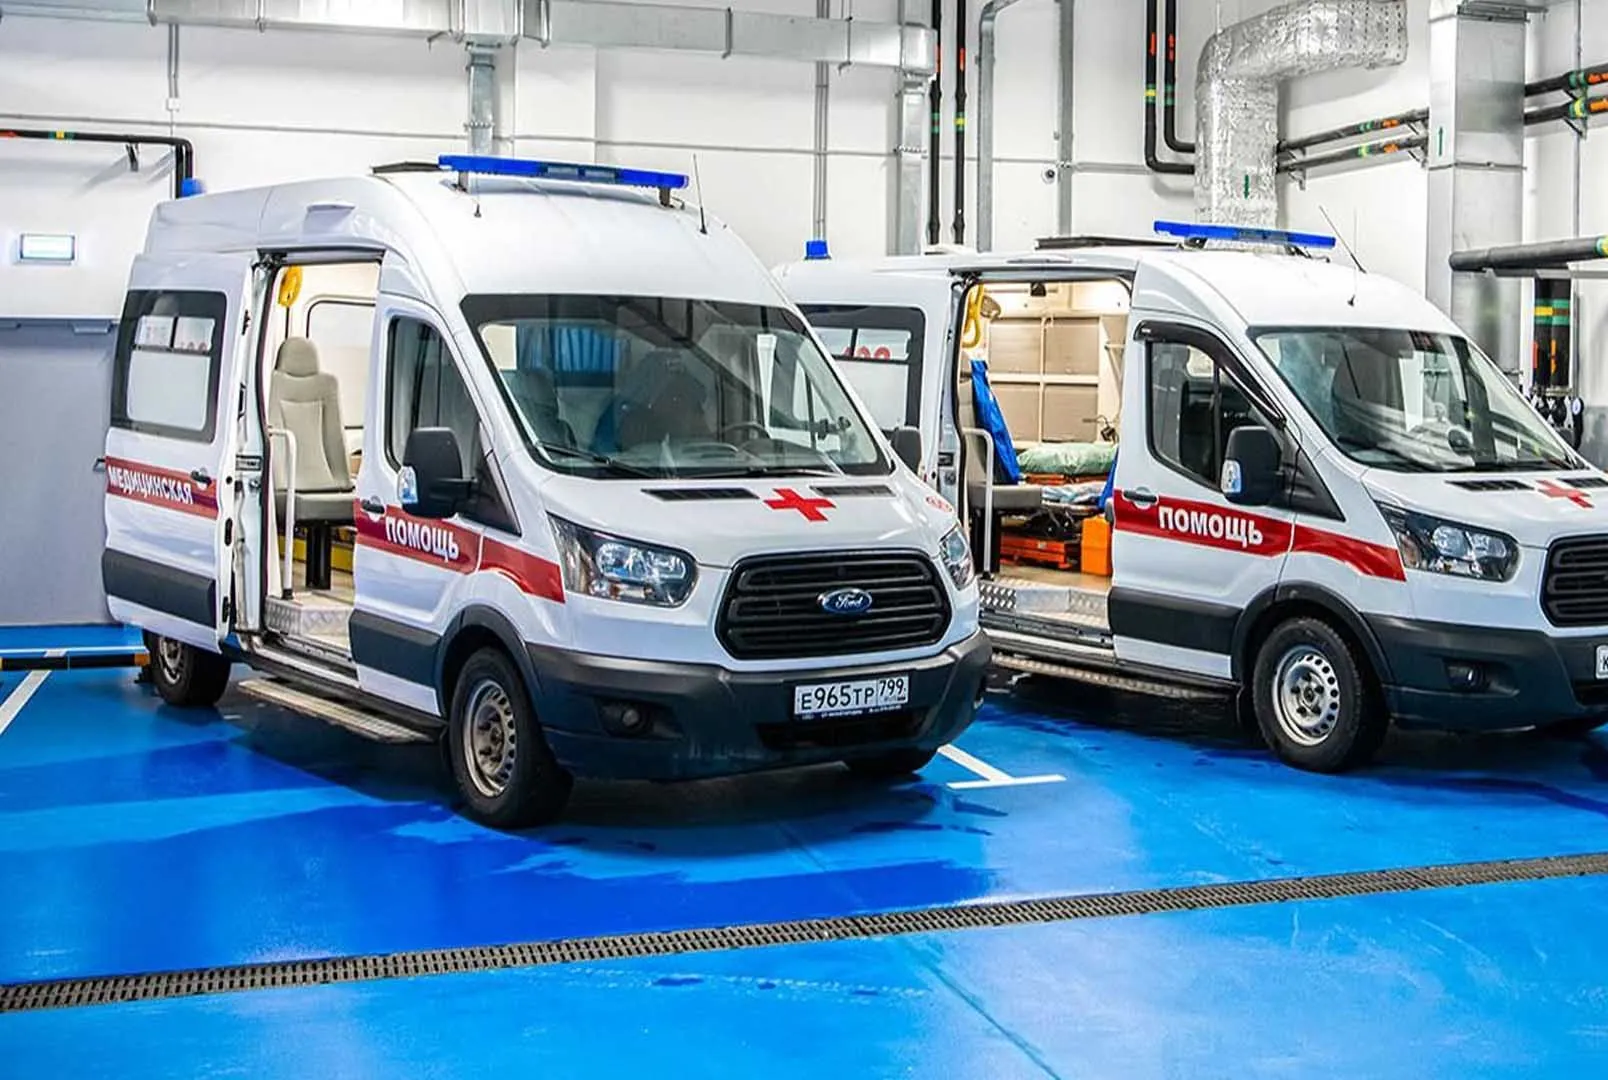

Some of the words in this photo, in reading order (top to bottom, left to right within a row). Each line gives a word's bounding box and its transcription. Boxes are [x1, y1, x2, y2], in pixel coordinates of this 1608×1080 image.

[108, 465, 194, 505] МЕДИЦИНСКАЯ
[385, 516, 460, 563] ПОМОЩЬ
[1158, 505, 1263, 548] ПОМОЩЬ
[835, 594, 863, 609] Ford
